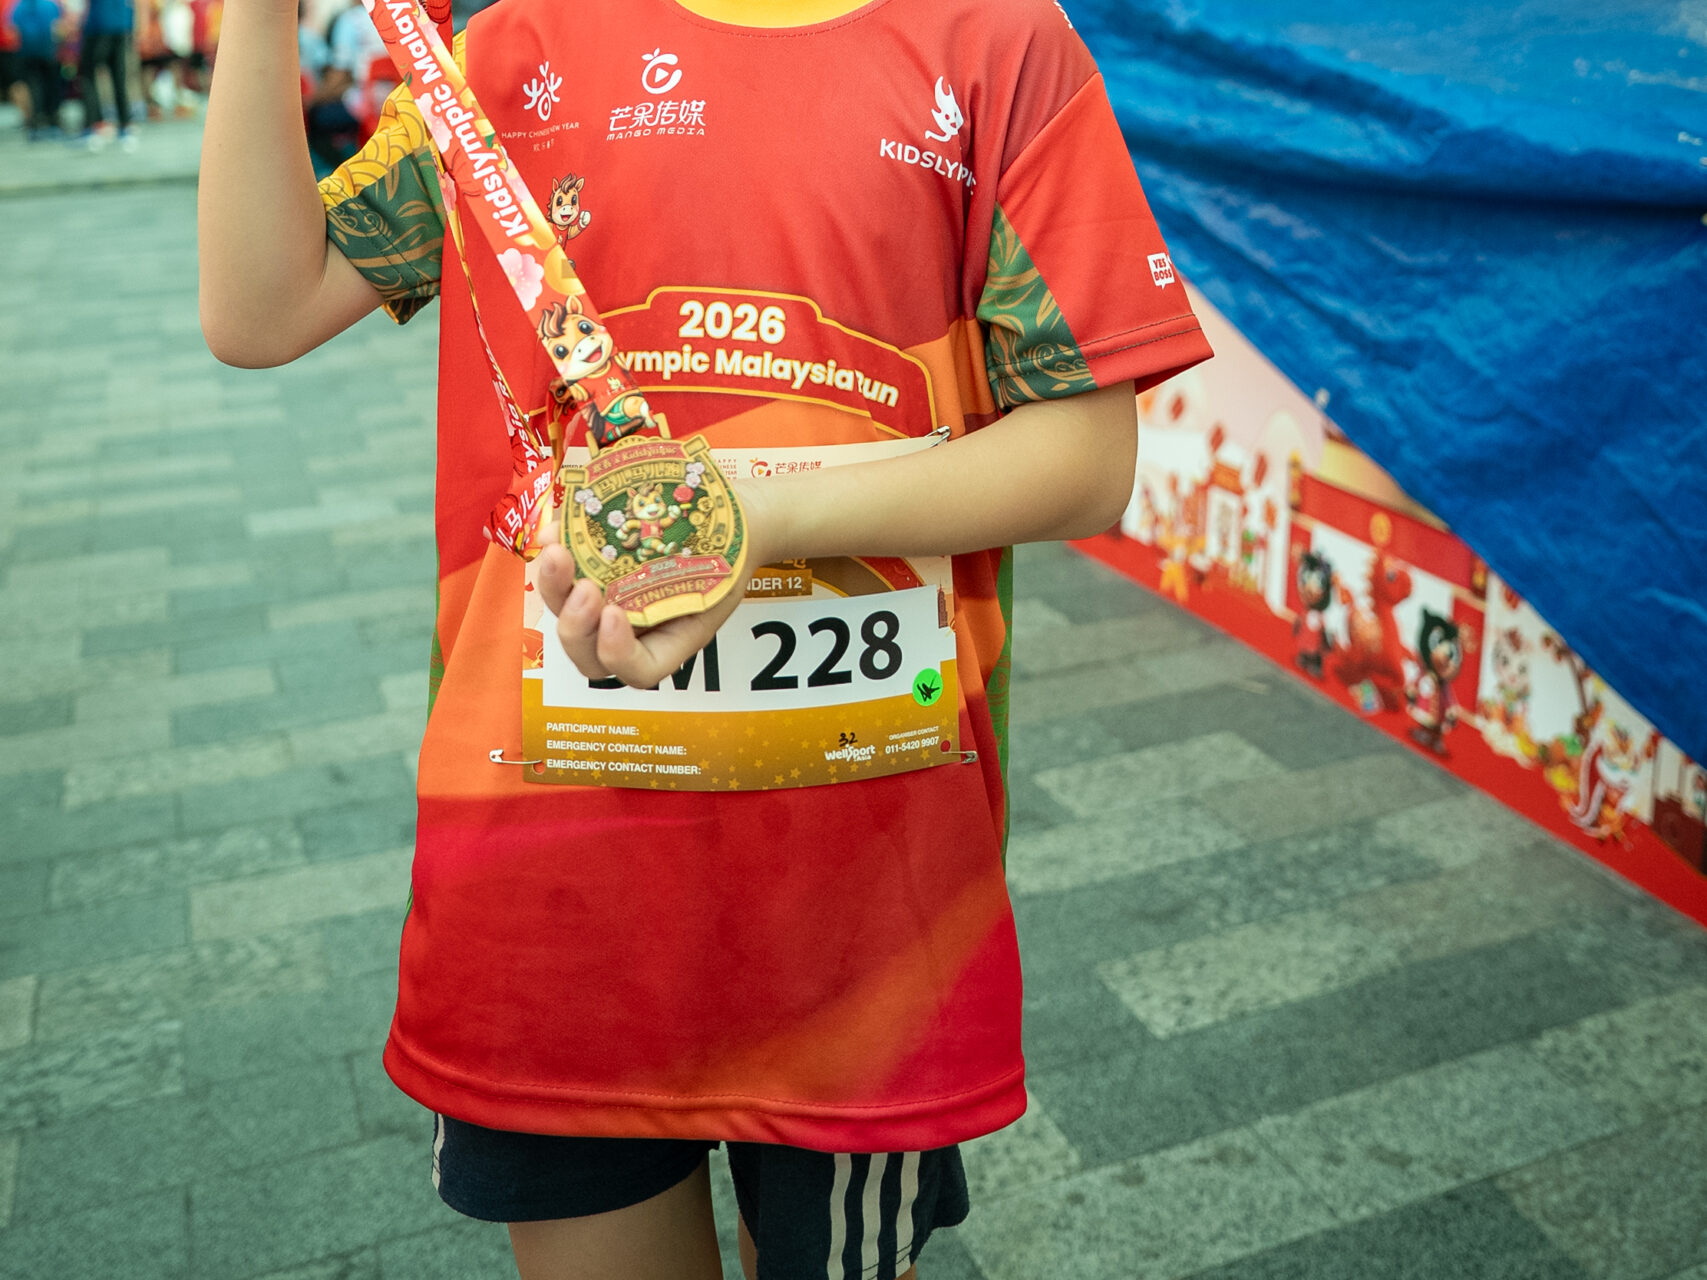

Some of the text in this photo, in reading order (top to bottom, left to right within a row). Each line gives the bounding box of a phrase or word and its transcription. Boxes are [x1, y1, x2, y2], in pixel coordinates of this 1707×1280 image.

[609, 99, 707, 132] 芒果传媒
[501, 131, 527, 140] HAPPY
[562, 121, 580, 131] YEAR
[606, 126, 705, 141] MANGO MEDIA
[433, 84, 531, 238] Kidslympic
[1152, 257, 1167, 269] YES
[1154, 268, 1173, 281] BOSS
[678, 299, 786, 345] 2026
[619, 344, 711, 381] ympic
[714, 349, 859, 390] Malaysia
[494, 469, 553, 554] 儿马儿跑
[787, 576, 802, 590] 12
[635, 578, 706, 609] FINISHER
[750, 609, 903, 692] 228
[546, 722, 640, 736] PARTICIPANT NAME:
[917, 726, 940, 736] CONTACT
[546, 739, 687, 756] EMERGENCY CONTACT NAME:
[885, 736, 940, 755] 011-5420 9907
[546, 758, 702, 776] EMERGENCY CONTACT NUMBER:
